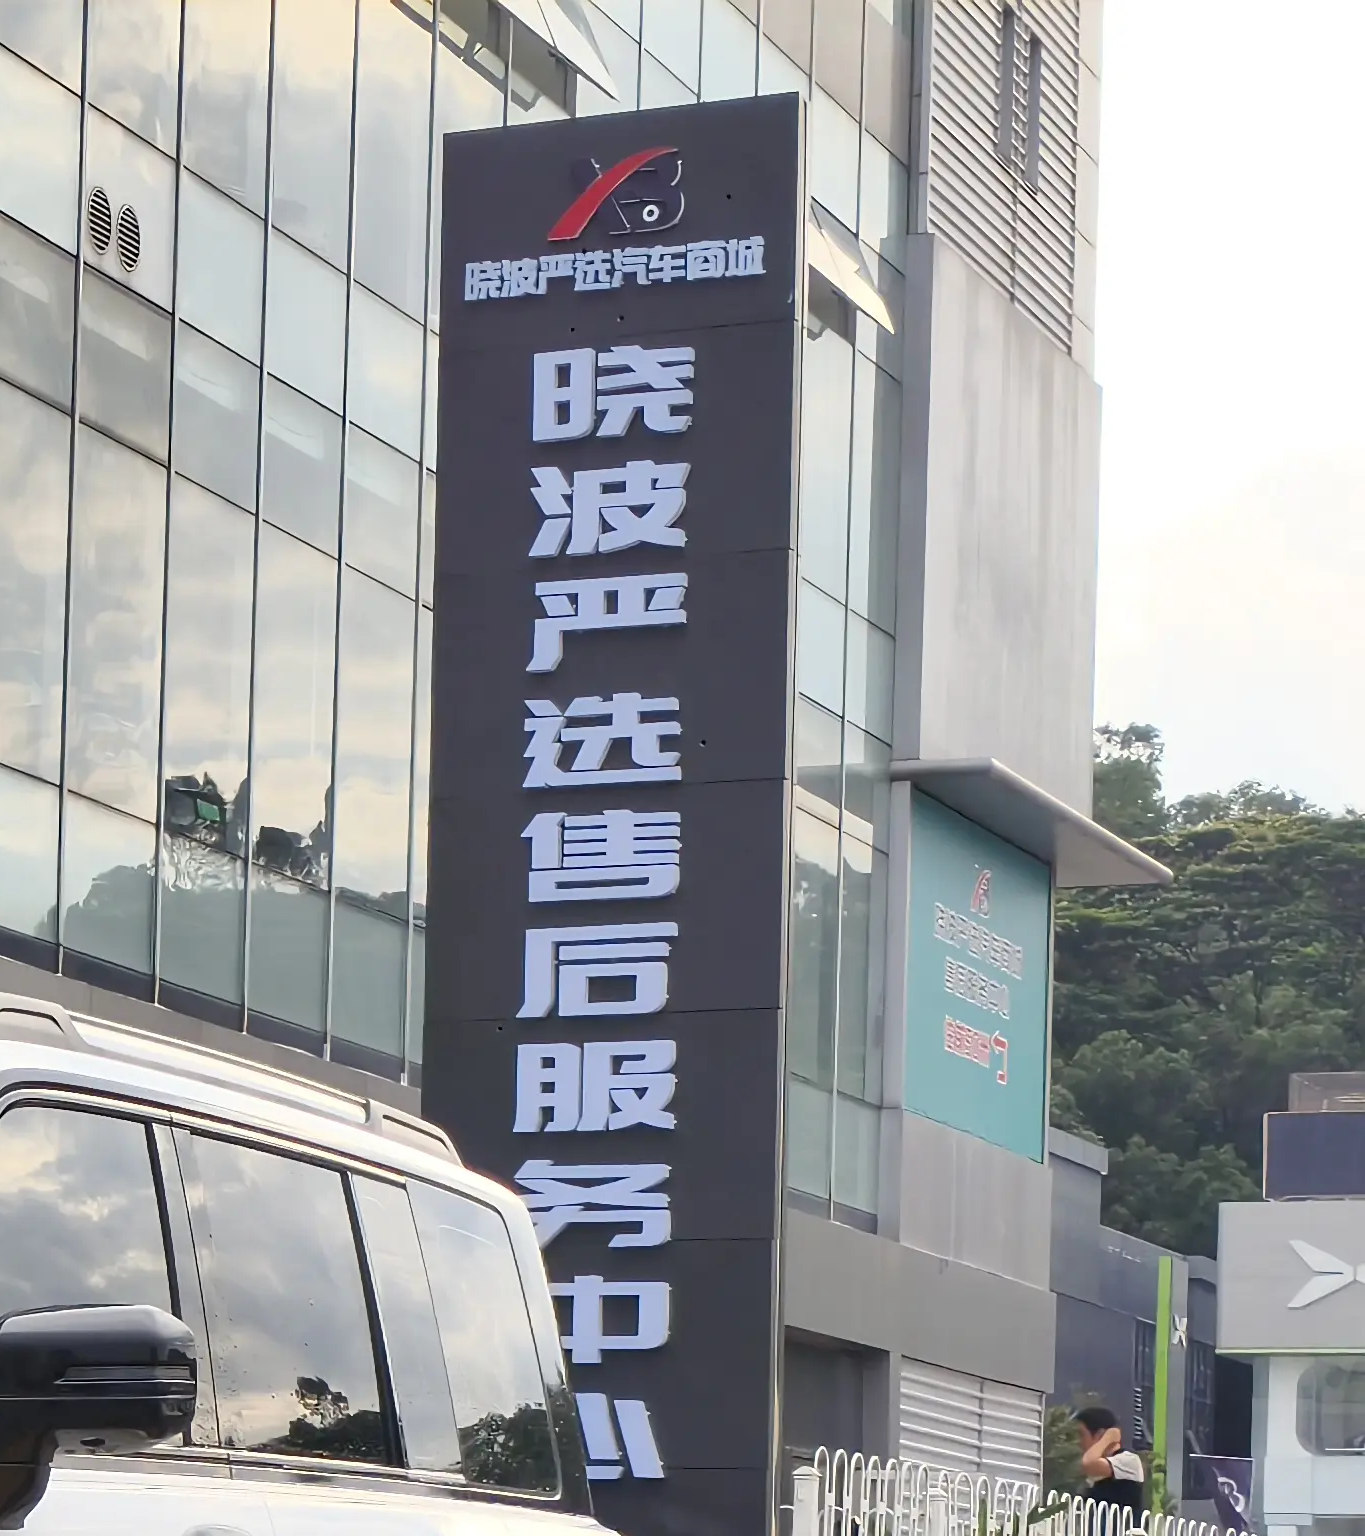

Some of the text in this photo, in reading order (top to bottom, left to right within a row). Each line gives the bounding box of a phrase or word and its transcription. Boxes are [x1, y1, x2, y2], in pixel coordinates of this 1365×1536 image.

[464, 236, 767, 301] 晓波严选汽车商城
